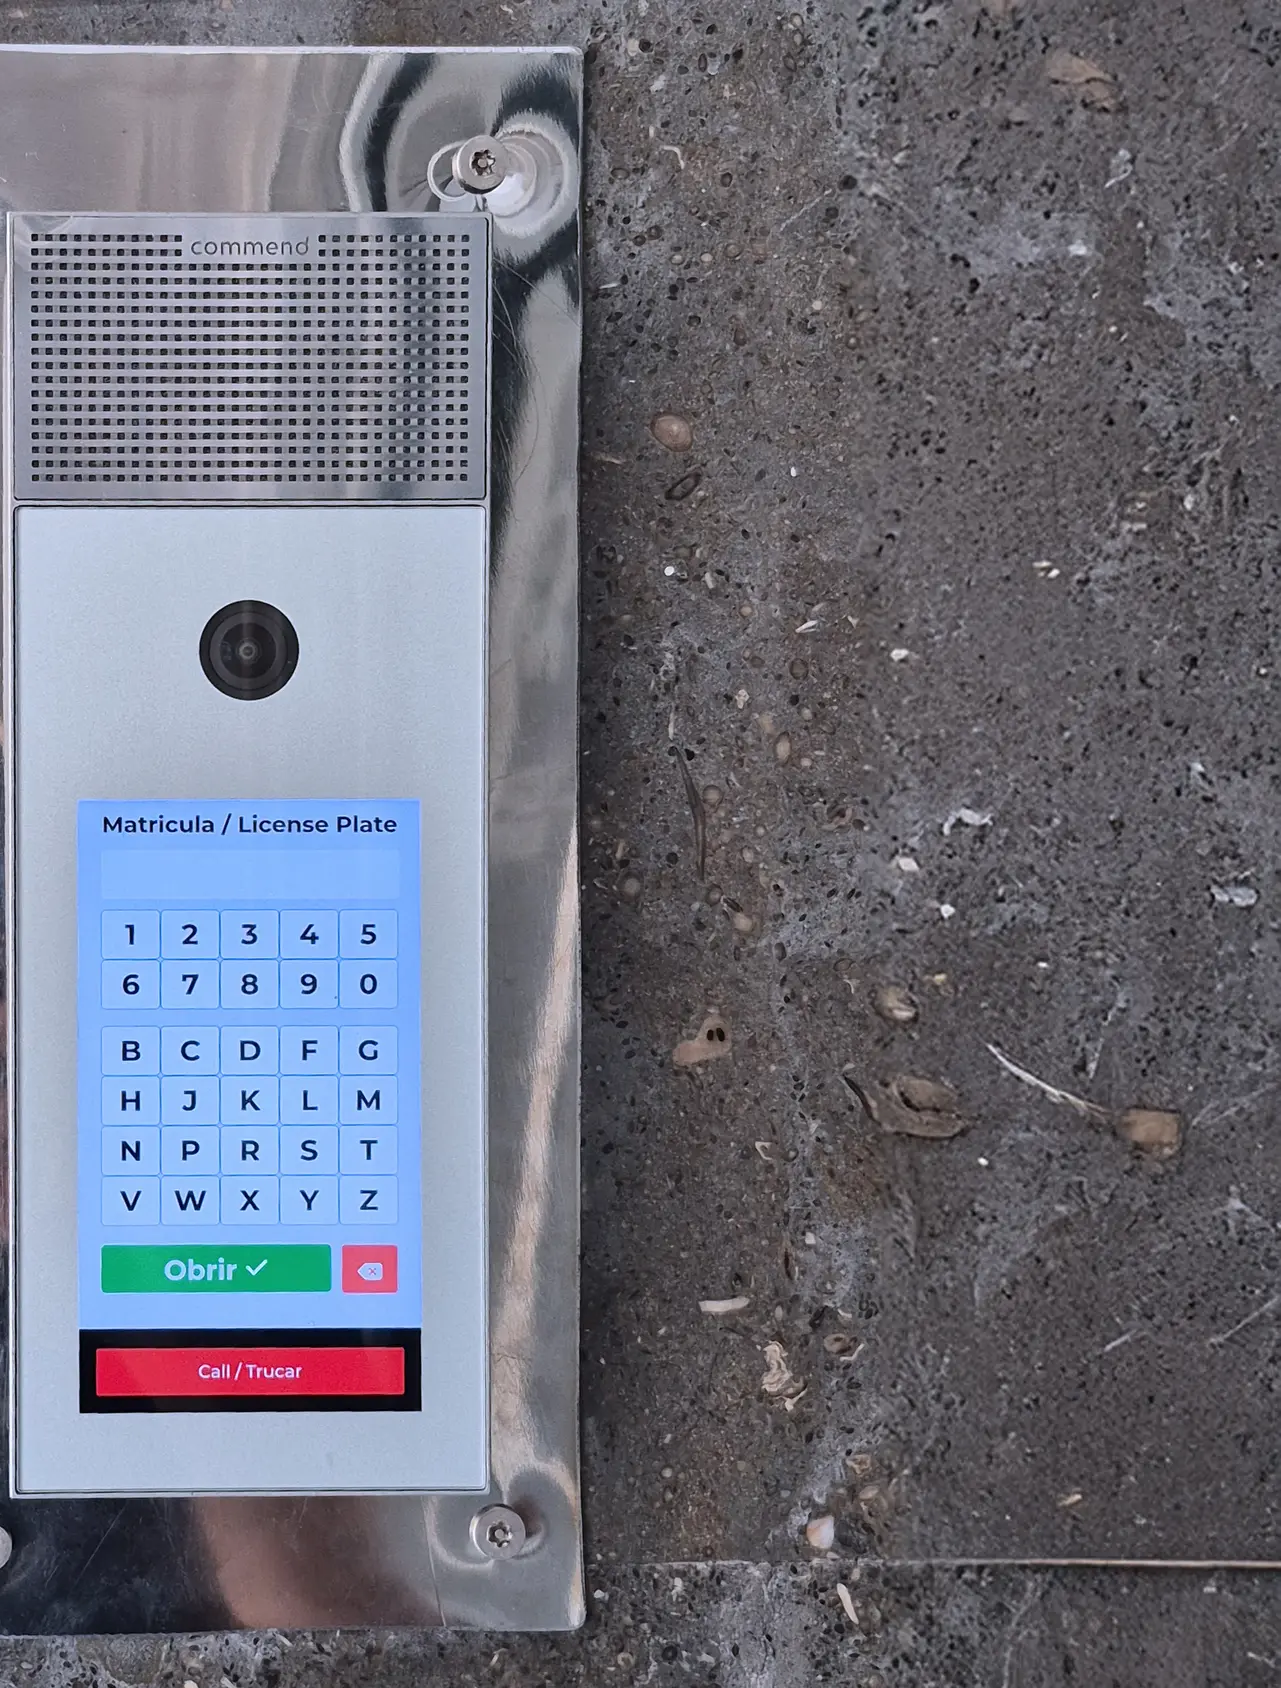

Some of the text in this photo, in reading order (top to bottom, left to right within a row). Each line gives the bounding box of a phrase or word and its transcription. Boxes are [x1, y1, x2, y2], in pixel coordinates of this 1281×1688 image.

[190, 235, 310, 257] commend
[103, 812, 398, 836] Matricula / License Plate
[124, 923, 377, 946] 1 2 3 4 5
[122, 973, 378, 995] 6 7 8 9 0
[121, 1039, 379, 1062] B C D F G
[121, 1089, 381, 1112] H J K L M
[121, 1139, 379, 1162] N P R S T
[120, 1189, 379, 1212] V W X Y Z
[163, 1256, 238, 1282] Obrir
[198, 1361, 303, 1381] Call / Trucar
